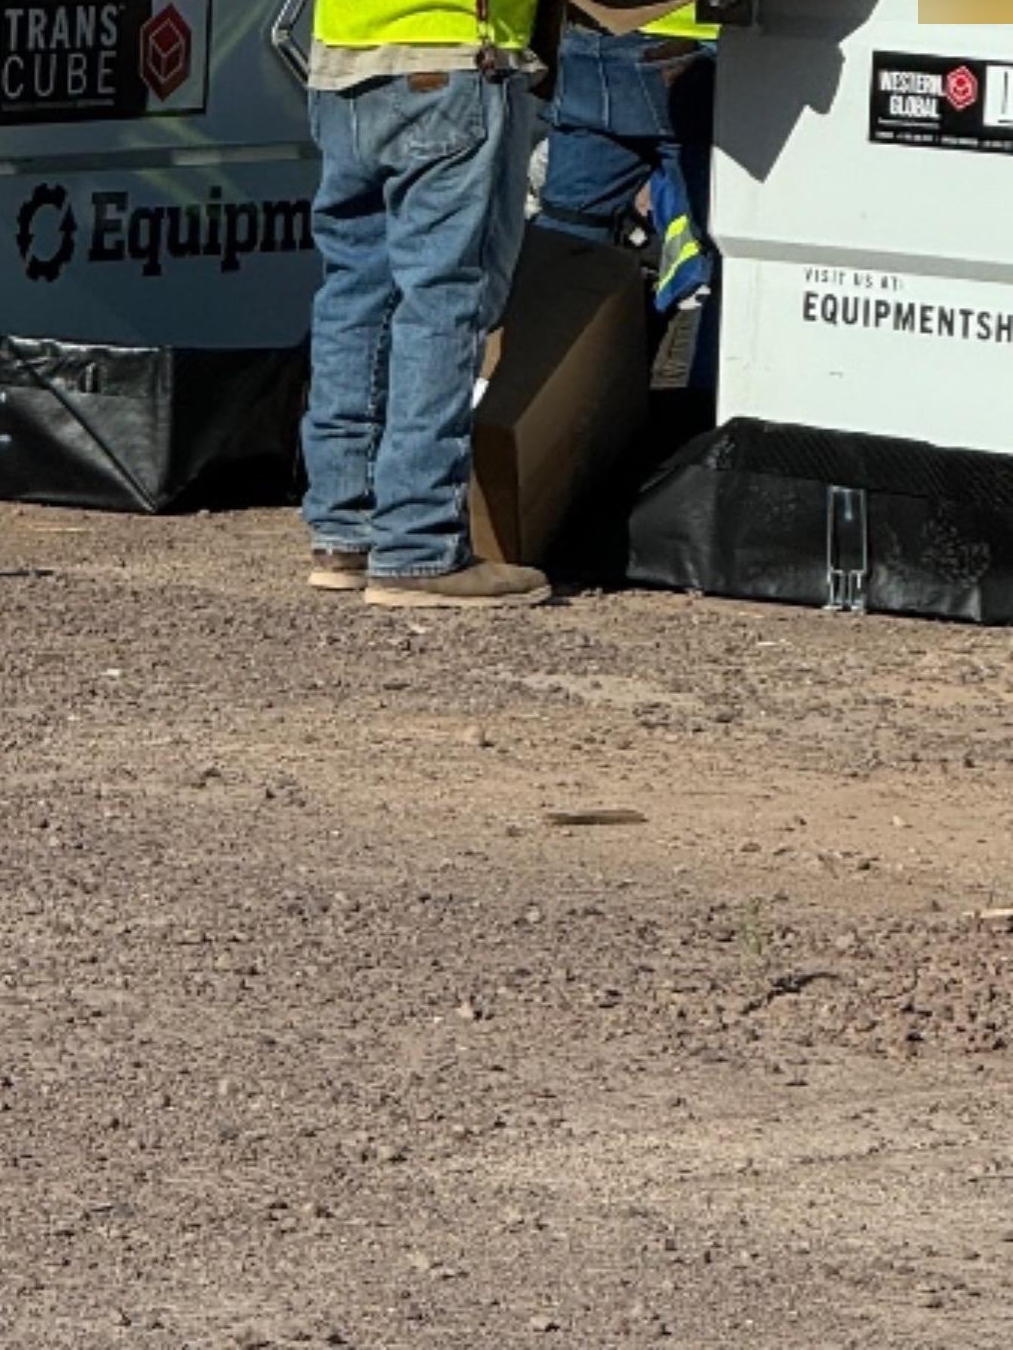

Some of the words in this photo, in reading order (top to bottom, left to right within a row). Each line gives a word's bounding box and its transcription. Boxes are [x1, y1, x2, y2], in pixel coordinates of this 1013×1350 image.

[4, 3, 119, 52] TRANS
[1, 51, 117, 99] CUBE
[803, 267, 846, 286] VISIT
[853, 272, 873, 289] US
[802, 290, 1013, 344] EQUIPMENTSH
